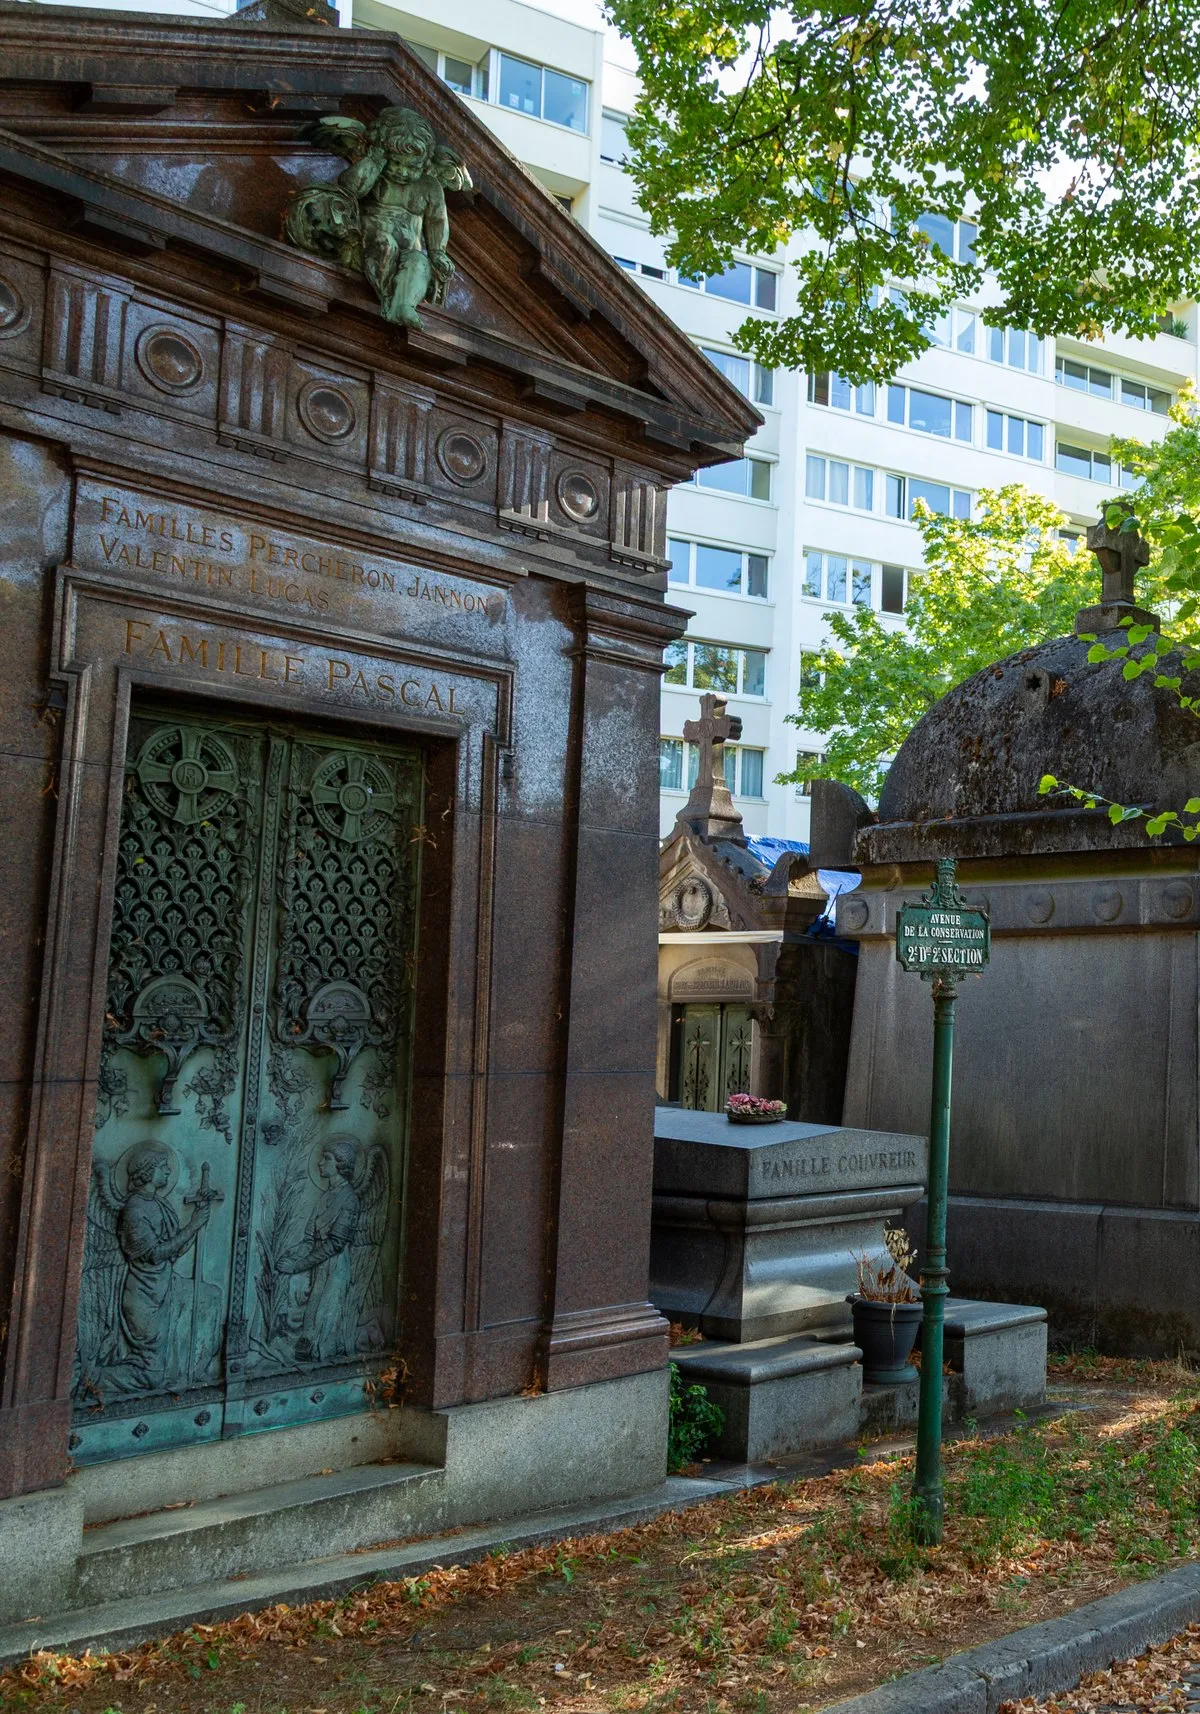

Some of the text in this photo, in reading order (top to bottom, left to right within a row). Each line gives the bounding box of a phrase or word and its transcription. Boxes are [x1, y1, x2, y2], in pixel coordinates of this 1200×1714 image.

[101, 496, 233, 552] FAMILLES
[407, 576, 490, 616] JANNON
[100, 534, 329, 610] VALENTIN LUCAS
[123, 619, 466, 716] FAMILLE PASCAL
[904, 925, 984, 939] DE LA CONSERVATION
[930, 913, 961, 925] AVENUE
[941, 947, 983, 964] SECTION
[762, 1150, 916, 1179] FAMILLE COUVREUR
